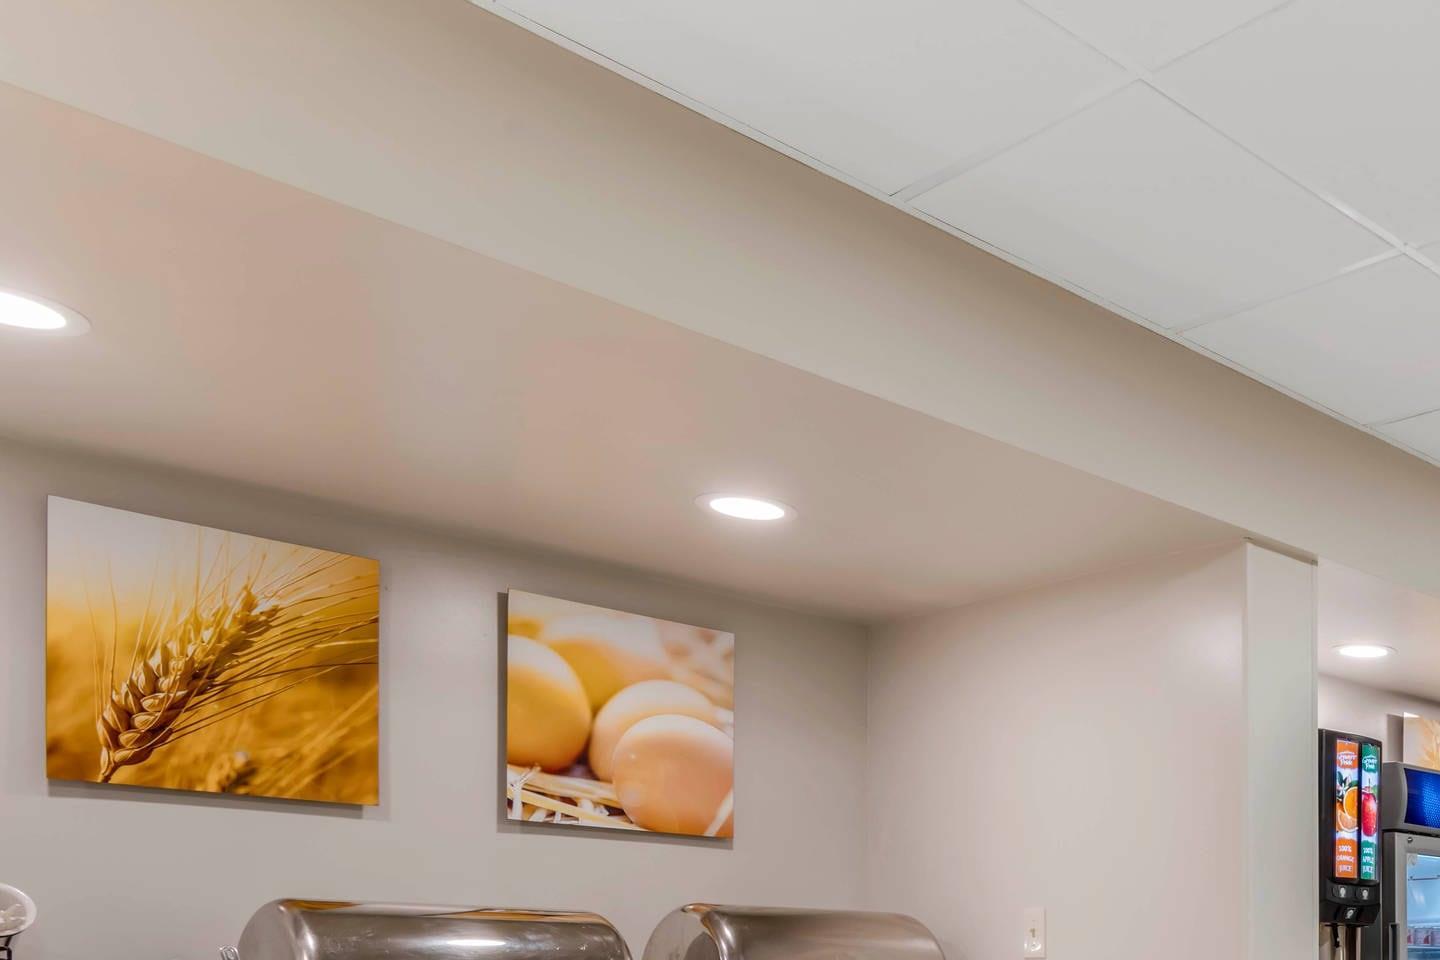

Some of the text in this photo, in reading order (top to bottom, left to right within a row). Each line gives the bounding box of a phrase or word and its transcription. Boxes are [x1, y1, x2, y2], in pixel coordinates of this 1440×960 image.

[1362, 856, 1374, 864] APPLE
[1338, 864, 1352, 873] JUICE
[1362, 866, 1373, 874] JUICE
